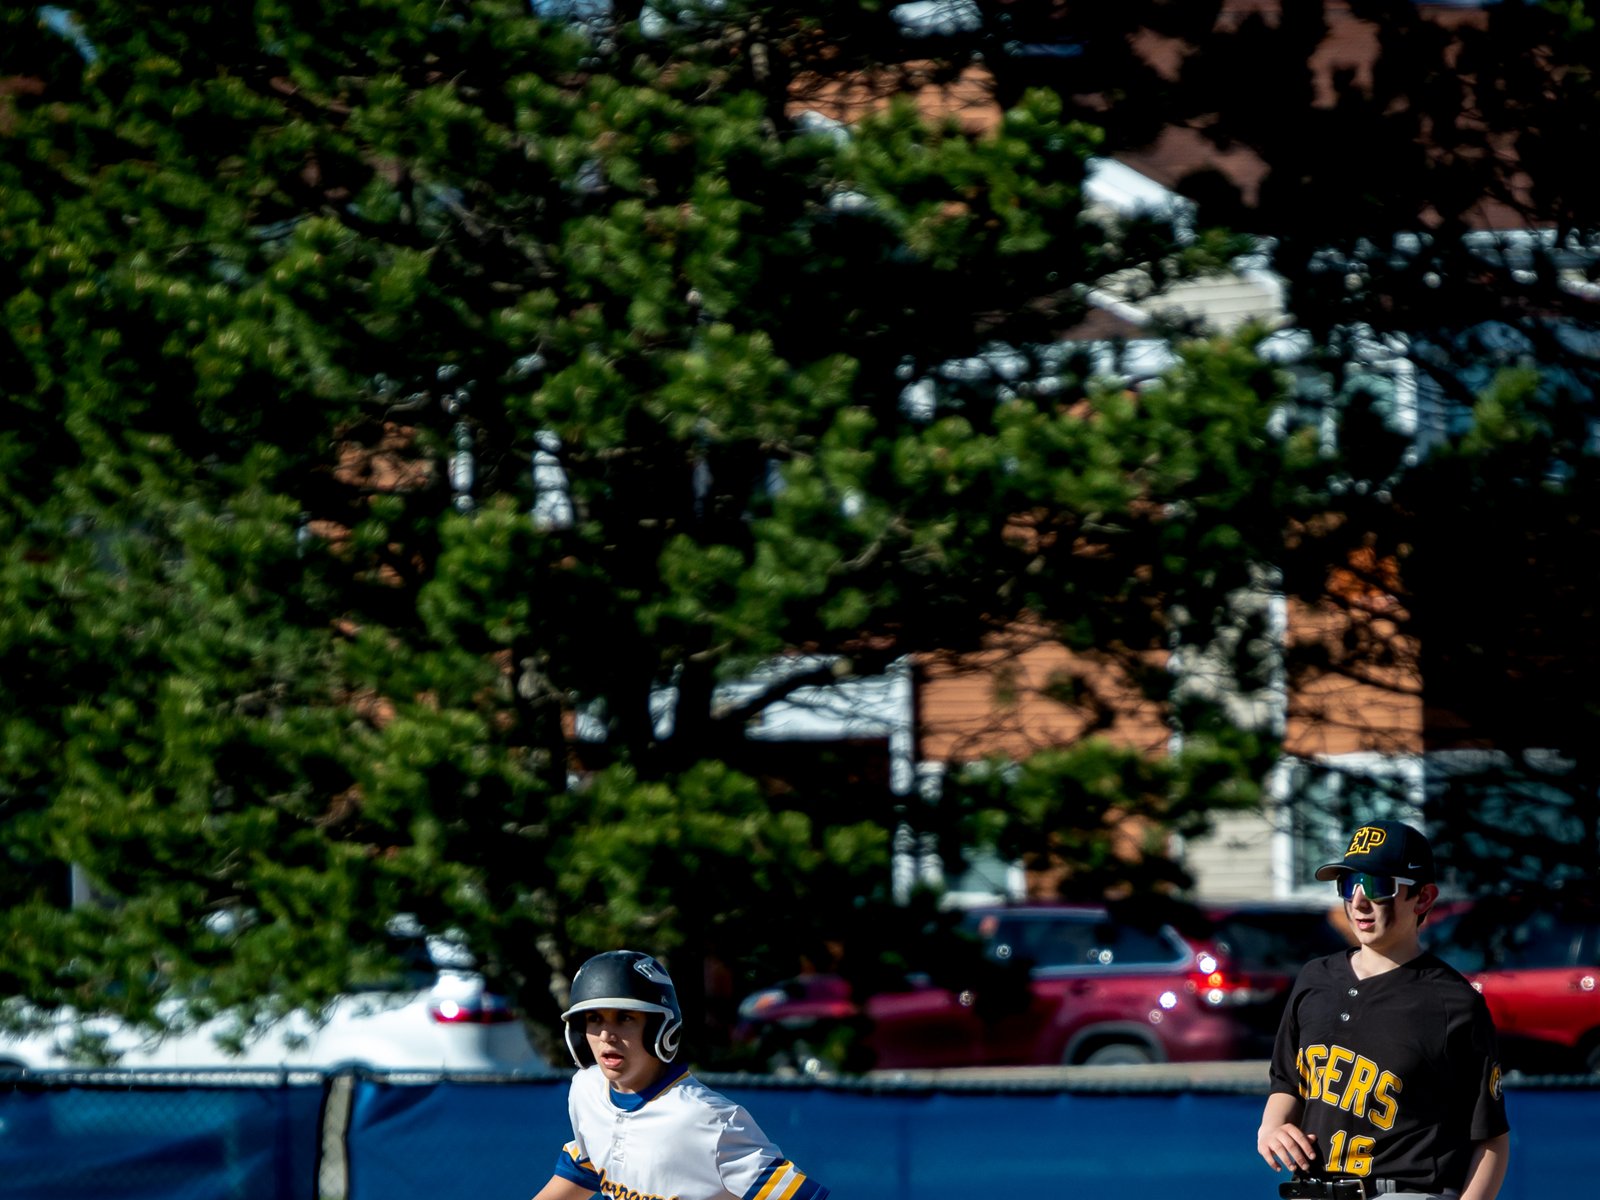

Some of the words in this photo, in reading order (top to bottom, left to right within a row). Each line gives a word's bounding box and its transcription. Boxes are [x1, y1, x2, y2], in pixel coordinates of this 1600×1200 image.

[1344, 826, 1387, 857] EP
[1296, 1044, 1403, 1130] IGERS
[1326, 1129, 1376, 1177] 16
